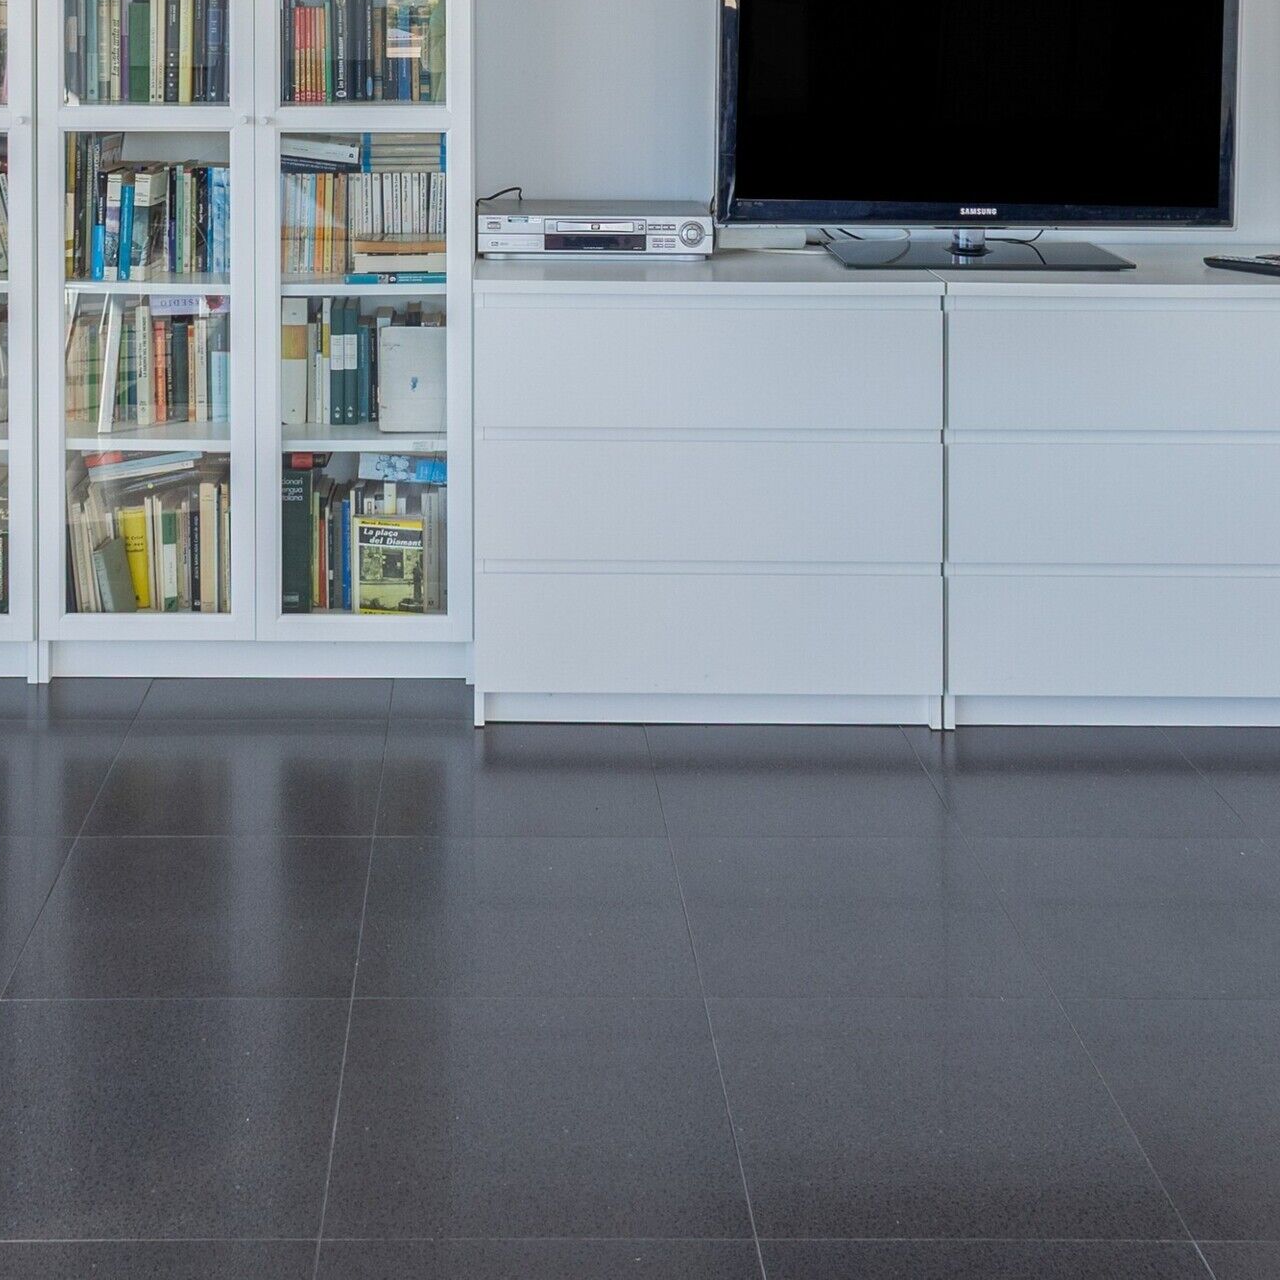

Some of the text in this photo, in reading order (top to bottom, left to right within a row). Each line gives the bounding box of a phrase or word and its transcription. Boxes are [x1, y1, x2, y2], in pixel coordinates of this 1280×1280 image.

[160, 298, 199, 307] SEDIO
[363, 527, 399, 537] La plaça
[369, 536, 422, 547] del Diamant
